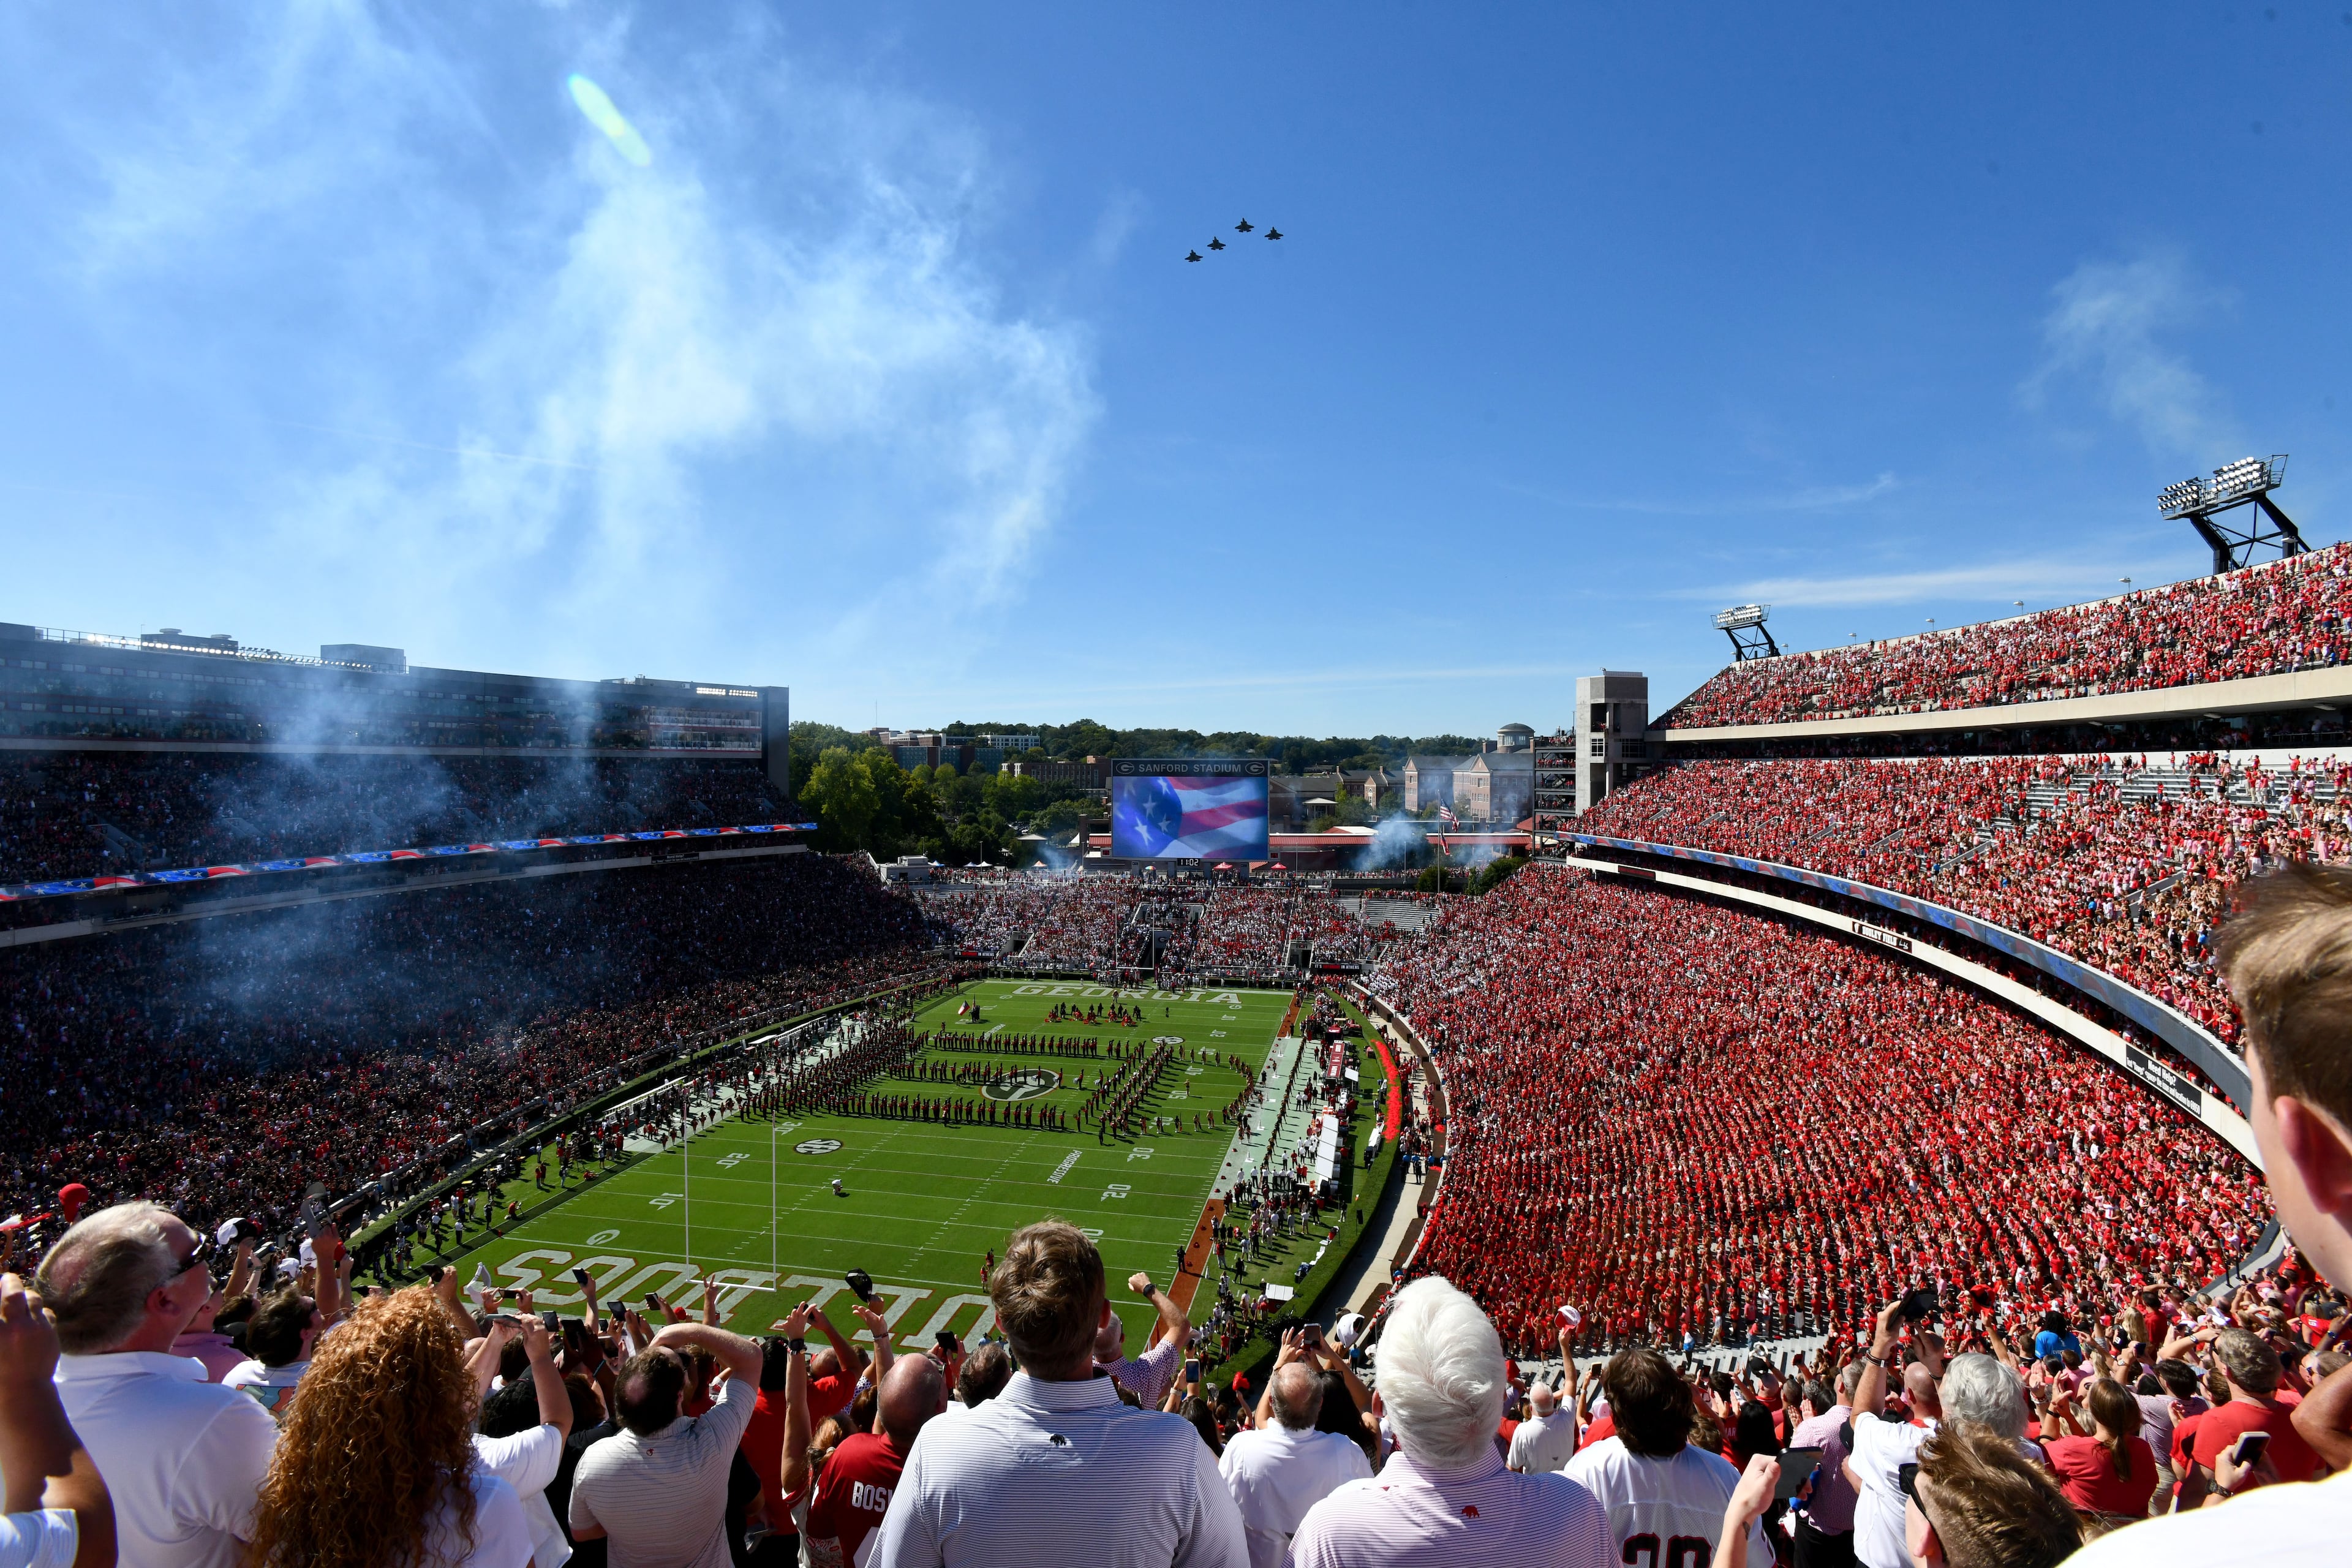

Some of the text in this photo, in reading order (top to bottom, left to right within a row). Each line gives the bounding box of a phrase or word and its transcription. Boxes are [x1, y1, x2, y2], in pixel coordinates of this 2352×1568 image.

[1139, 764, 1241, 772] SANFORD STADIUM
[1012, 985, 1242, 1004] GEORGIA
[2147, 1060, 2176, 1086] Need Help?
[2175, 1088, 2187, 1105] location
[796, 1139, 843, 1155] SEC
[1128, 1147, 1155, 1159] 30
[716, 1152, 750, 1165] 20
[1046, 1149, 1083, 1184] PROGRESSIVE
[649, 1192, 684, 1205] 10
[1102, 1183, 1132, 1199] 20
[586, 1229, 620, 1245] G
[462, 1249, 1000, 1354] ULLDOGS
